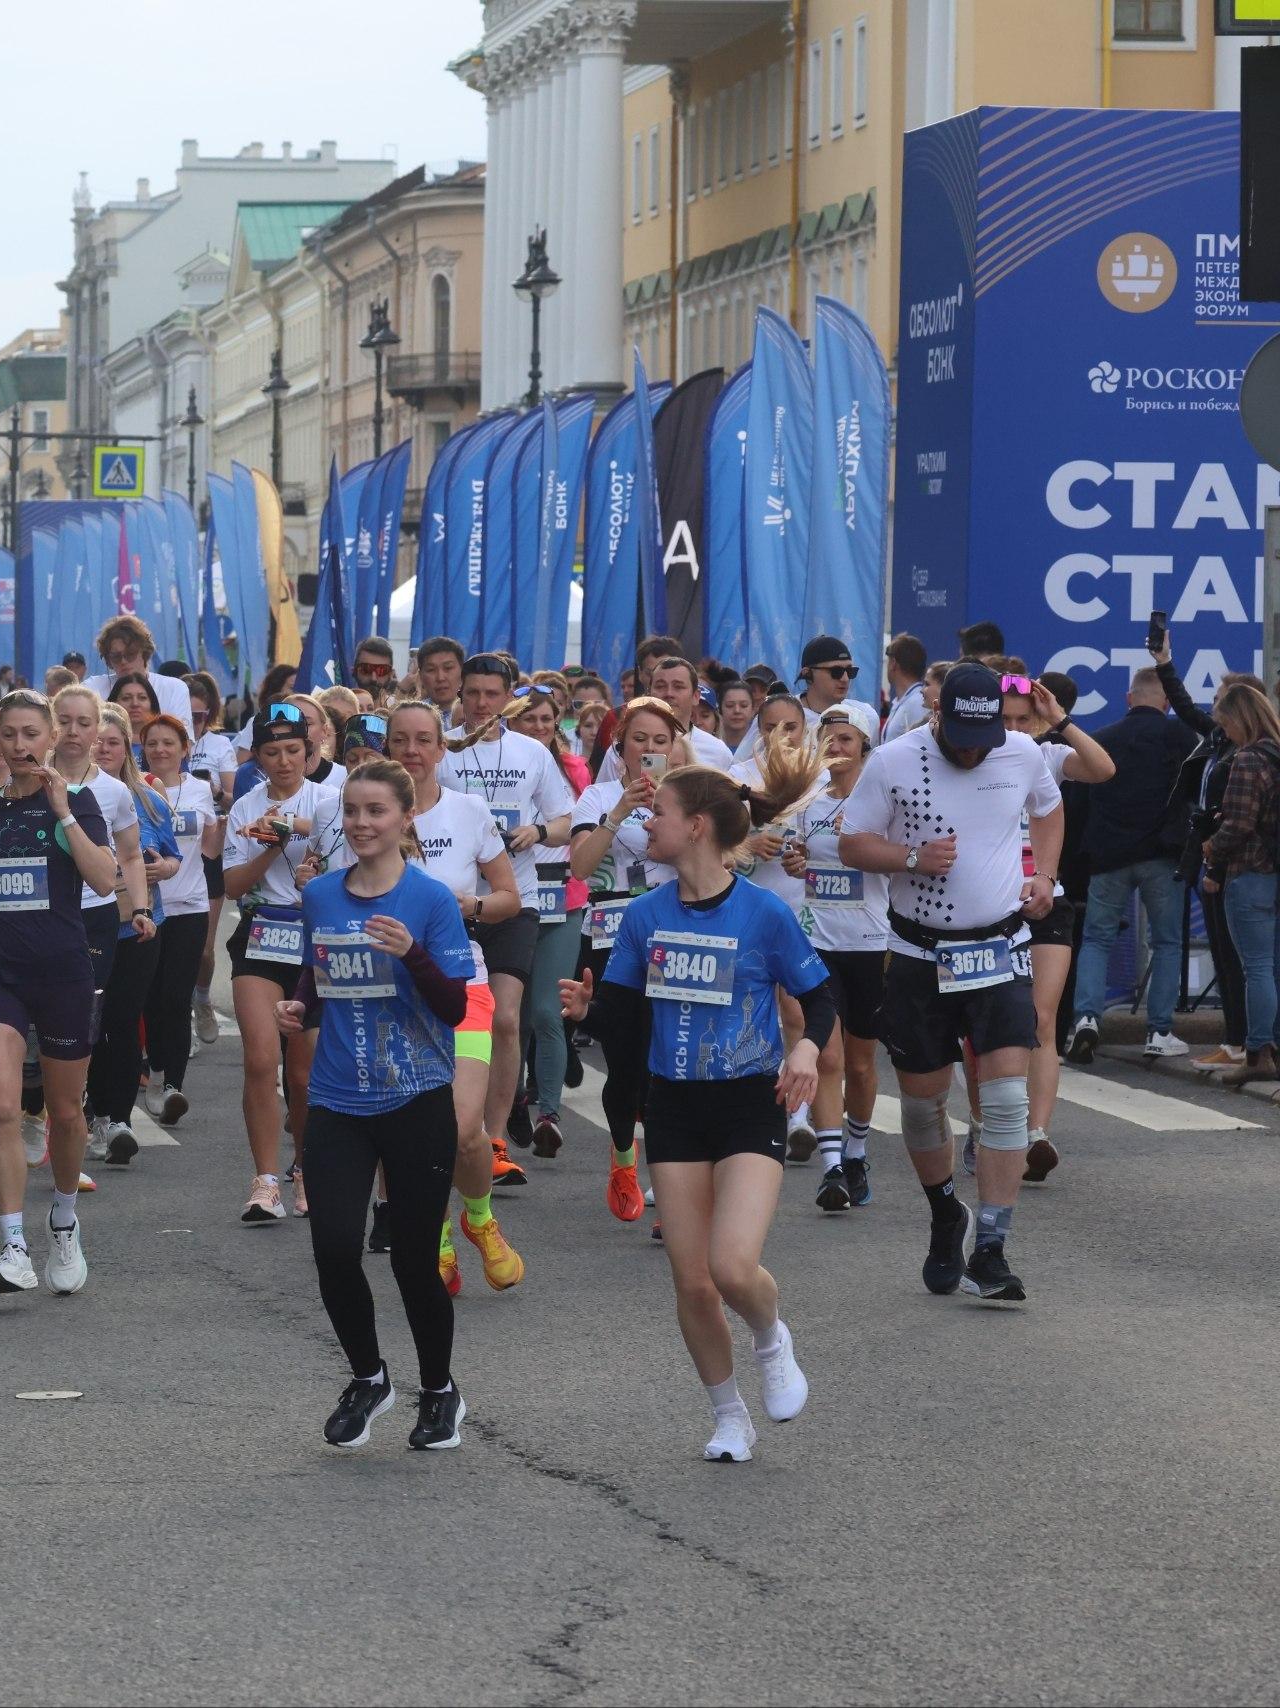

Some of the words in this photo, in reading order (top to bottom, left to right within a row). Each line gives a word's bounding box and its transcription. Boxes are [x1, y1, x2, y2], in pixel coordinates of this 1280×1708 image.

[1194, 304, 1249, 317] ФОРУМ
[1125, 367, 1247, 391] РОСКОН
[1125, 397, 1175, 414] Борись
[1177, 400, 1187, 410] и
[1190, 398, 1241, 412] побежд
[1044, 552, 1264, 623] СТА
[455, 769, 526, 780] УРАЛХИМ
[815, 874, 851, 896] 3728
[260, 927, 301, 950] 3829
[328, 952, 374, 980] 3841
[663, 951, 717, 983] 3840
[952, 949, 996, 975] 3678
